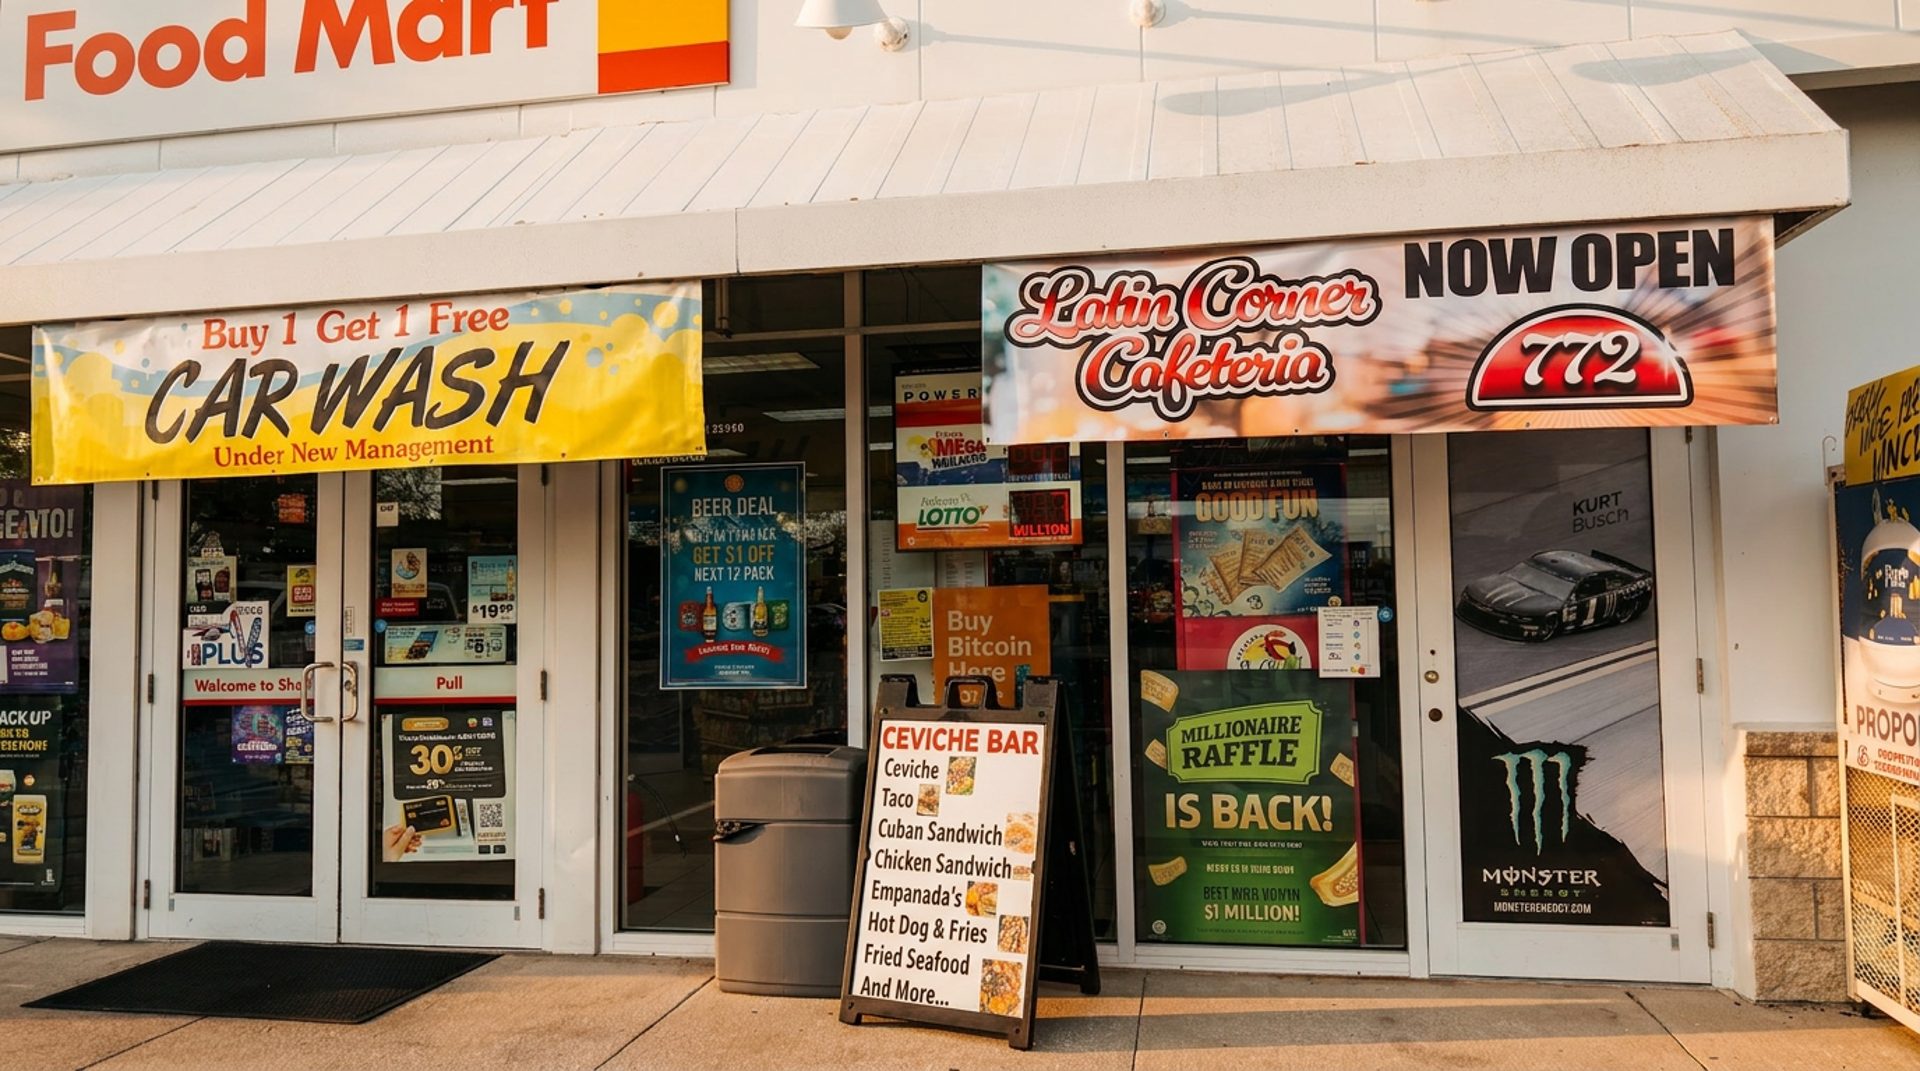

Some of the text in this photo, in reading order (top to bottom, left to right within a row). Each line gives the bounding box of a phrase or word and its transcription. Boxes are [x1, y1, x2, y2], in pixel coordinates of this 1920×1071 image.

[24, 0, 560, 101] Food Mart
[1404, 228, 1735, 299] NOW OPEN
[1008, 259, 1377, 345] Latin Corner
[202, 301, 509, 355] Buy 1 Get 1 Free
[1080, 331, 1331, 415] Cafeteria
[1521, 330, 1641, 388] 772
[144, 340, 571, 444] CAR WASH
[213, 436, 494, 468] Under New Management
[692, 496, 777, 517] BEER DEAL
[918, 506, 980, 526] LOTTO
[1268, 489, 1318, 520] FUN
[1573, 491, 1622, 516] KURT
[693, 546, 721, 564] GET
[748, 544, 775, 563] OFF
[694, 567, 724, 581] NEXT
[727, 566, 740, 580] 12
[947, 610, 993, 635] Buy
[202, 642, 264, 666] PLUS
[948, 635, 1032, 657] Bitcoin
[259, 680, 274, 691] to
[436, 675, 463, 690] Pull
[949, 661, 1006, 682] Here
[29, 710, 52, 725] UP
[1181, 715, 1302, 744] MILLIONAIRE
[1856, 704, 1920, 747] PROPO
[882, 726, 1039, 755] CEVICHE BAR
[1182, 739, 1299, 769] RAFFLE
[884, 758, 939, 779] Ceviche
[882, 788, 914, 809] Taco
[1165, 793, 1333, 832] IS BACK!
[878, 818, 1003, 846] Cuban Sandwich
[874, 849, 1011, 879] Chicken Sandwich
[871, 879, 962, 908] Empanada's
[1203, 886, 1229, 900] BEST
[1204, 903, 1300, 921] $1 MILLION!
[868, 911, 988, 944] Hot Dog & Fries
[864, 943, 970, 975] Fried Seafood
[860, 975, 949, 1006] And More...
